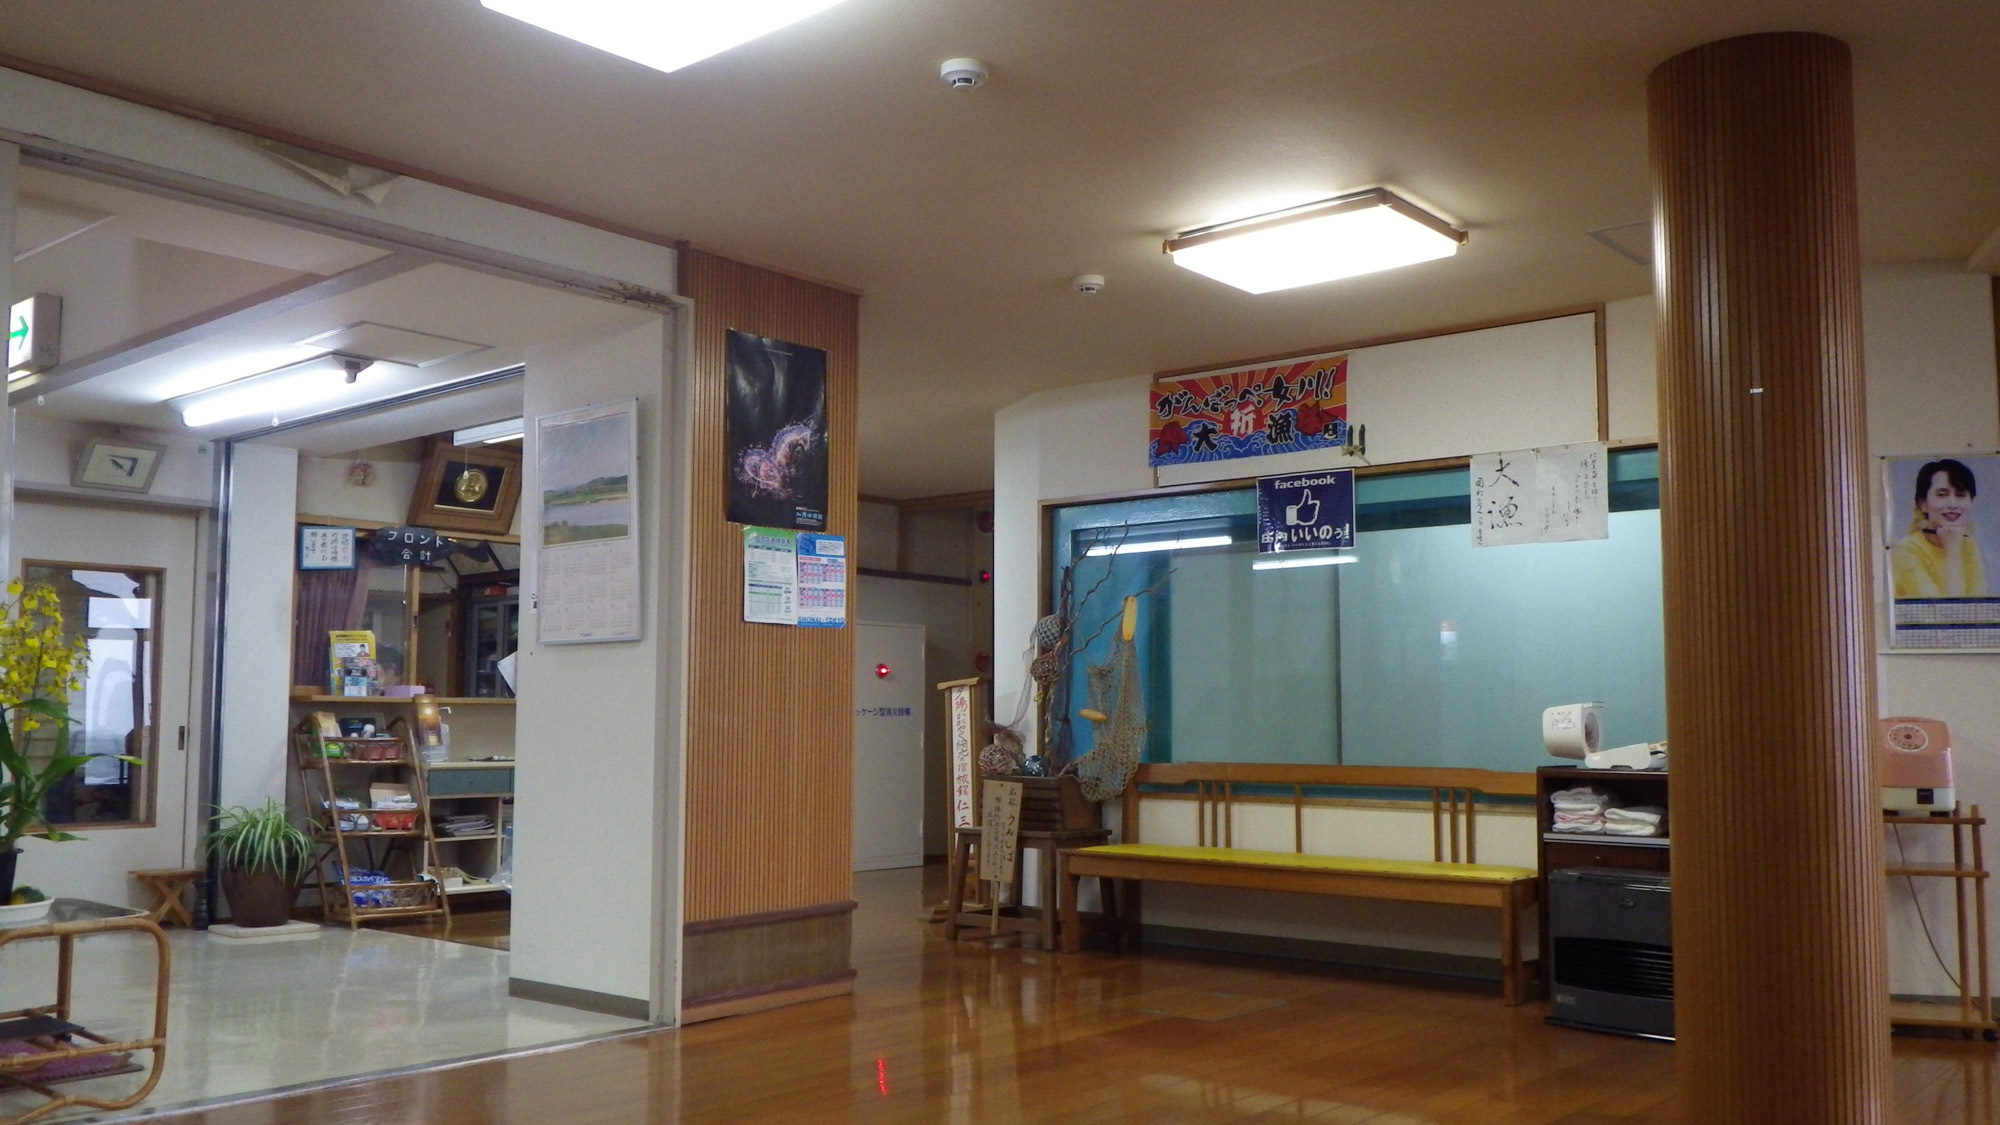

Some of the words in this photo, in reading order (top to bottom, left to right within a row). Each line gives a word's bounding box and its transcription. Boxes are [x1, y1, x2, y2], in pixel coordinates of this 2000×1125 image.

[1274, 475, 1336, 490] facebook
[387, 530, 443, 548] フロント
